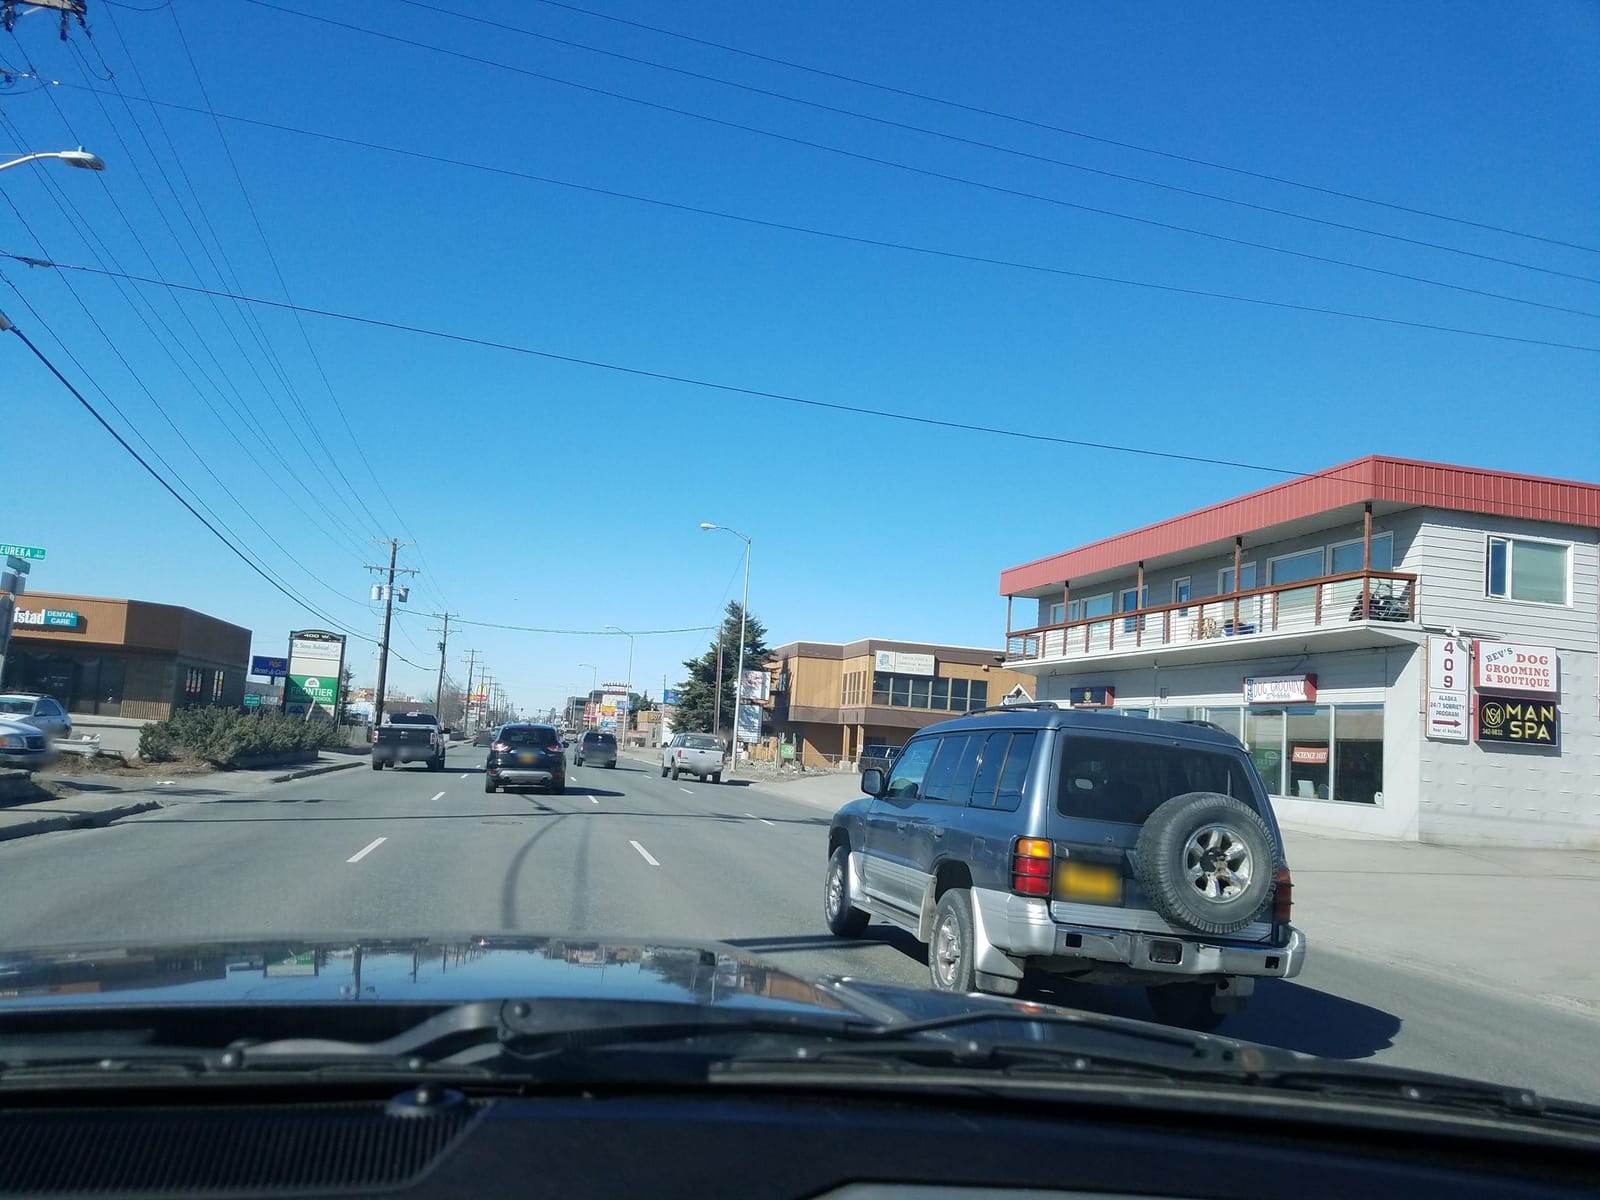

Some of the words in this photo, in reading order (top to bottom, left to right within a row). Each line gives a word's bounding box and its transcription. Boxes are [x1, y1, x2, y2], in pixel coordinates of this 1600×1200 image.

[0, 545, 31, 558] EUREKA
[13, 606, 46, 625] fstad
[47, 610, 75, 619] DENTAL
[50, 617, 71, 625] CARE
[1485, 647, 1513, 663] BEV'S
[1515, 653, 1549, 665] DOG
[1485, 663, 1550, 677] GROOMING
[1485, 674, 1493, 682] &
[1497, 674, 1550, 688] BOUTIQUE
[290, 686, 333, 698] FRONTIER
[1505, 703, 1554, 722] MAN
[1509, 721, 1551, 741] SPA
